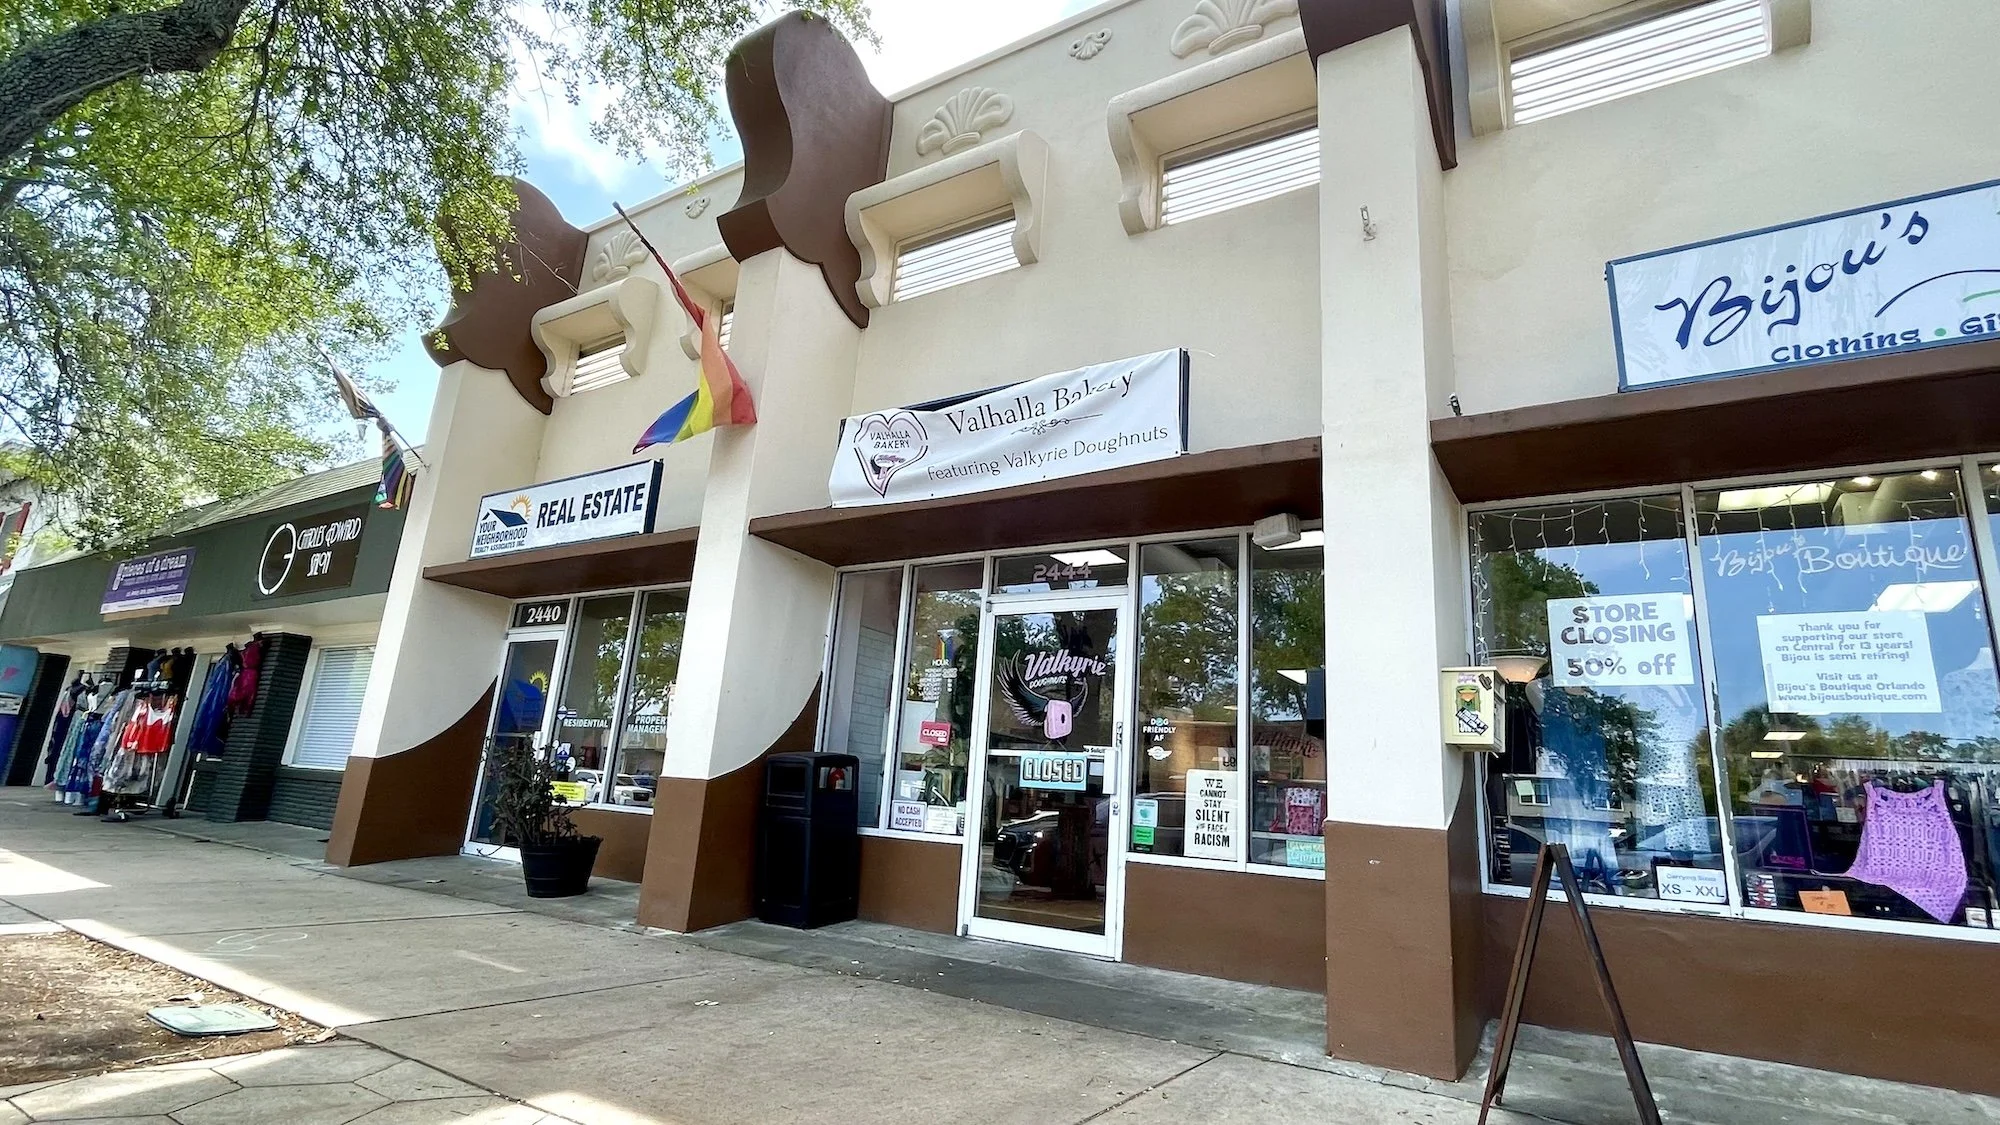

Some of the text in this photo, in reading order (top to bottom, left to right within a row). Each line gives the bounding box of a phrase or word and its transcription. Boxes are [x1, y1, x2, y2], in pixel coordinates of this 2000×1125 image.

[1654, 210, 1929, 349] Bijou's
[1771, 311, 2000, 363] Clothing Gi
[945, 396, 1046, 435] Valhalla
[870, 430, 911, 440] VALHALLA
[873, 440, 910, 449] BAKERY
[927, 425, 1168, 481] Featuring Valkyrie Doughnuts
[537, 482, 646, 528] REAL ESTATE
[480, 520, 497, 533] YOUR
[476, 527, 528, 546] NEIGHBORHOOD
[1799, 543, 1966, 574] Boutique
[1032, 561, 1092, 582] 2444
[526, 605, 561, 623] 2440
[1572, 602, 1659, 624] STORE
[1798, 621, 1881, 632] Thank you for
[1561, 622, 1676, 645] CLOSING
[1782, 631, 1904, 643] supporting our store
[1776, 640, 1913, 652] on Central for 13 years!
[1781, 650, 1910, 664] Bijou is semi retiring!
[1024, 649, 1107, 681] Valkyrie
[1567, 653, 1676, 677] 50% off
[1816, 673, 1843, 681] Visit
[1866, 672, 1879, 680] at
[1777, 682, 1925, 693] Bijou's Boutique Orlando
[1778, 692, 1927, 703] www.bijousboutique.com
[563, 718, 609, 728] RESIDENTIAL
[635, 715, 667, 724] PROPER
[627, 724, 666, 734] MANAGEM
[921, 728, 948, 738] CLOSED
[1142, 726, 1177, 734] FRIENDLY
[1023, 757, 1084, 783] CLOSED
[1204, 778, 1223, 789] WE
[1200, 789, 1227, 798] CANNOT
[897, 805, 921, 815] NO CASH
[1203, 800, 1221, 808] STAY
[1195, 809, 1230, 823] SILENT
[895, 817, 922, 828] ACCEPTED
[1207, 823, 1224, 833] FACE
[1194, 832, 1230, 848] RACISM
[1661, 883, 1682, 895] XS
[1695, 885, 1725, 897] XXL
